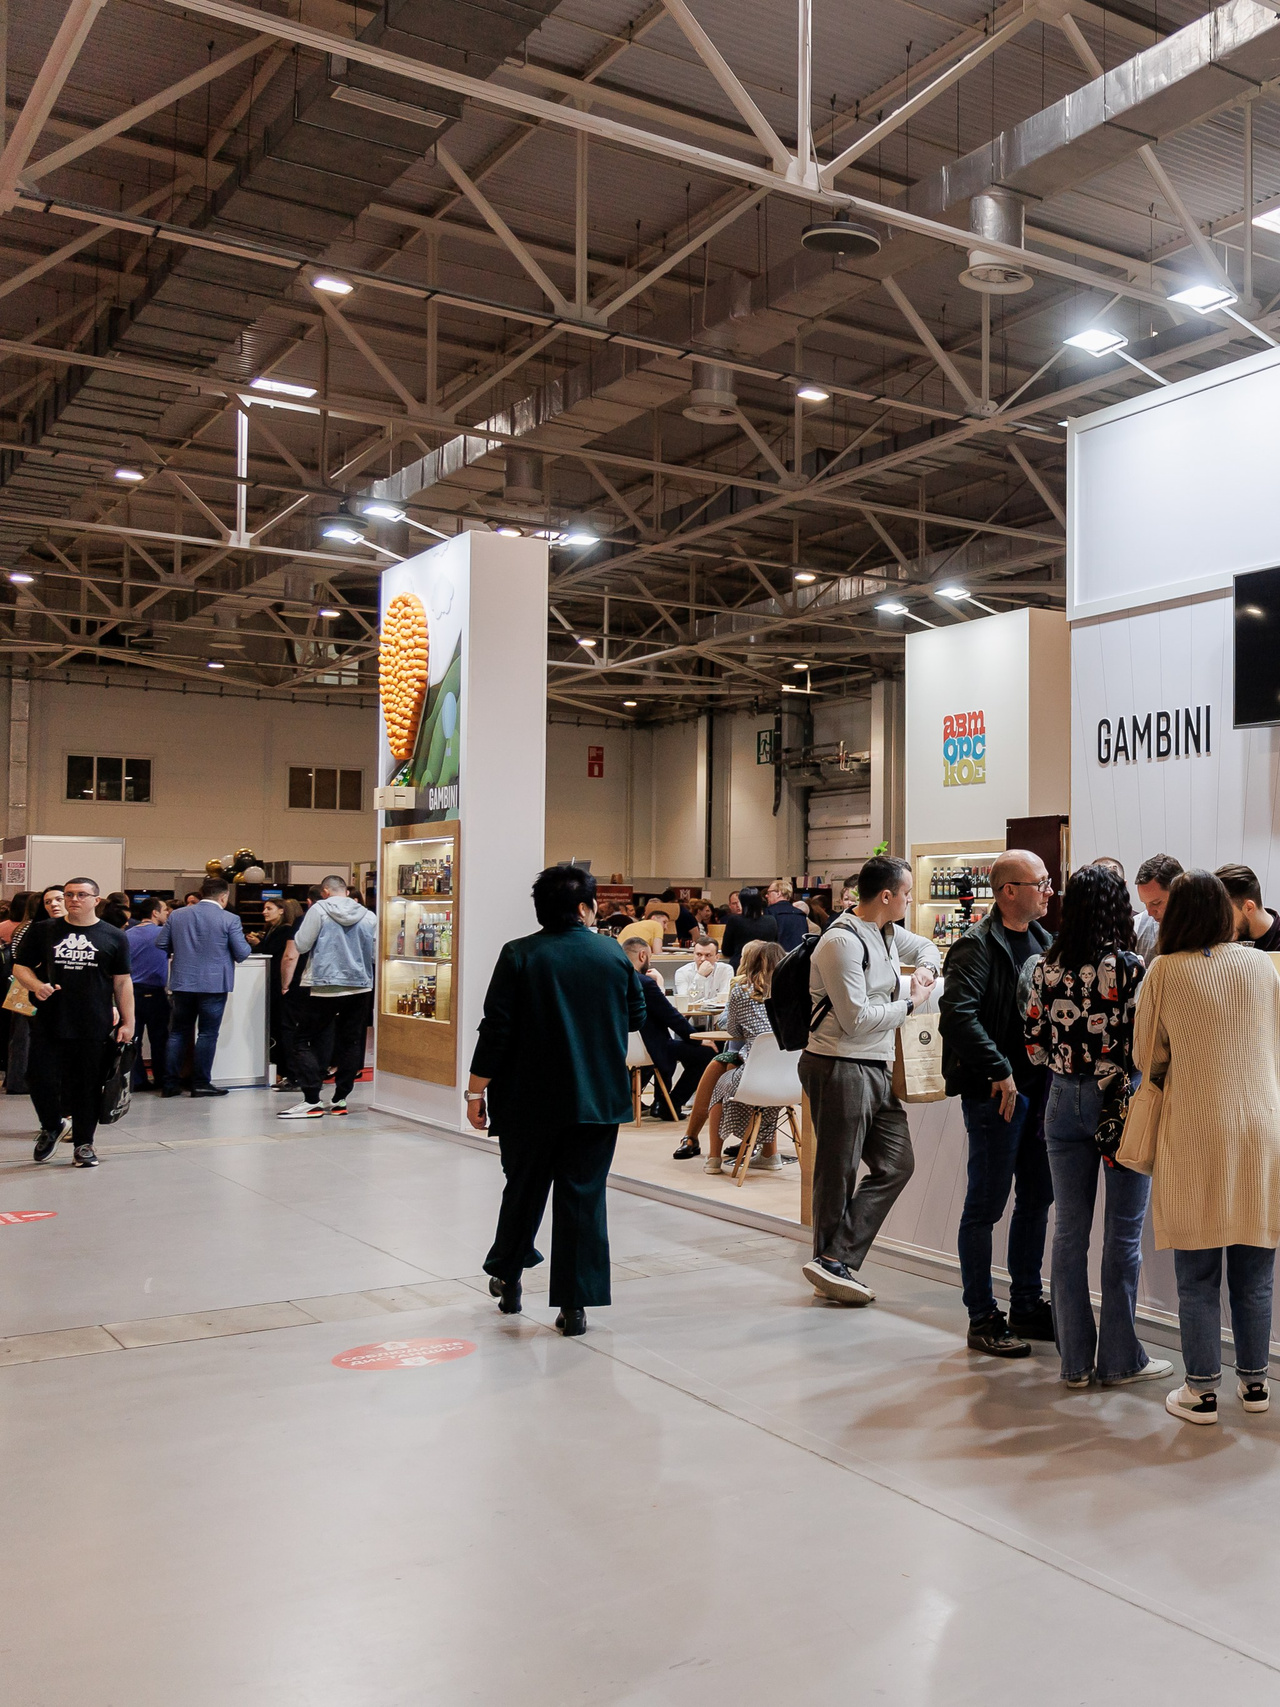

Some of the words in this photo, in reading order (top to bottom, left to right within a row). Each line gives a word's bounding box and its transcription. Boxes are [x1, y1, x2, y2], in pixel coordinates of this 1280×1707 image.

[1097, 704, 1211, 764] GAMBINI
[428, 784, 458, 811] GAMBINI
[55, 947, 96, 961] Kappa
[341, 1341, 464, 1362] СОБЛЮДАЙТЕ
[351, 1345, 464, 1366] ДИСТАНЦИЮ
